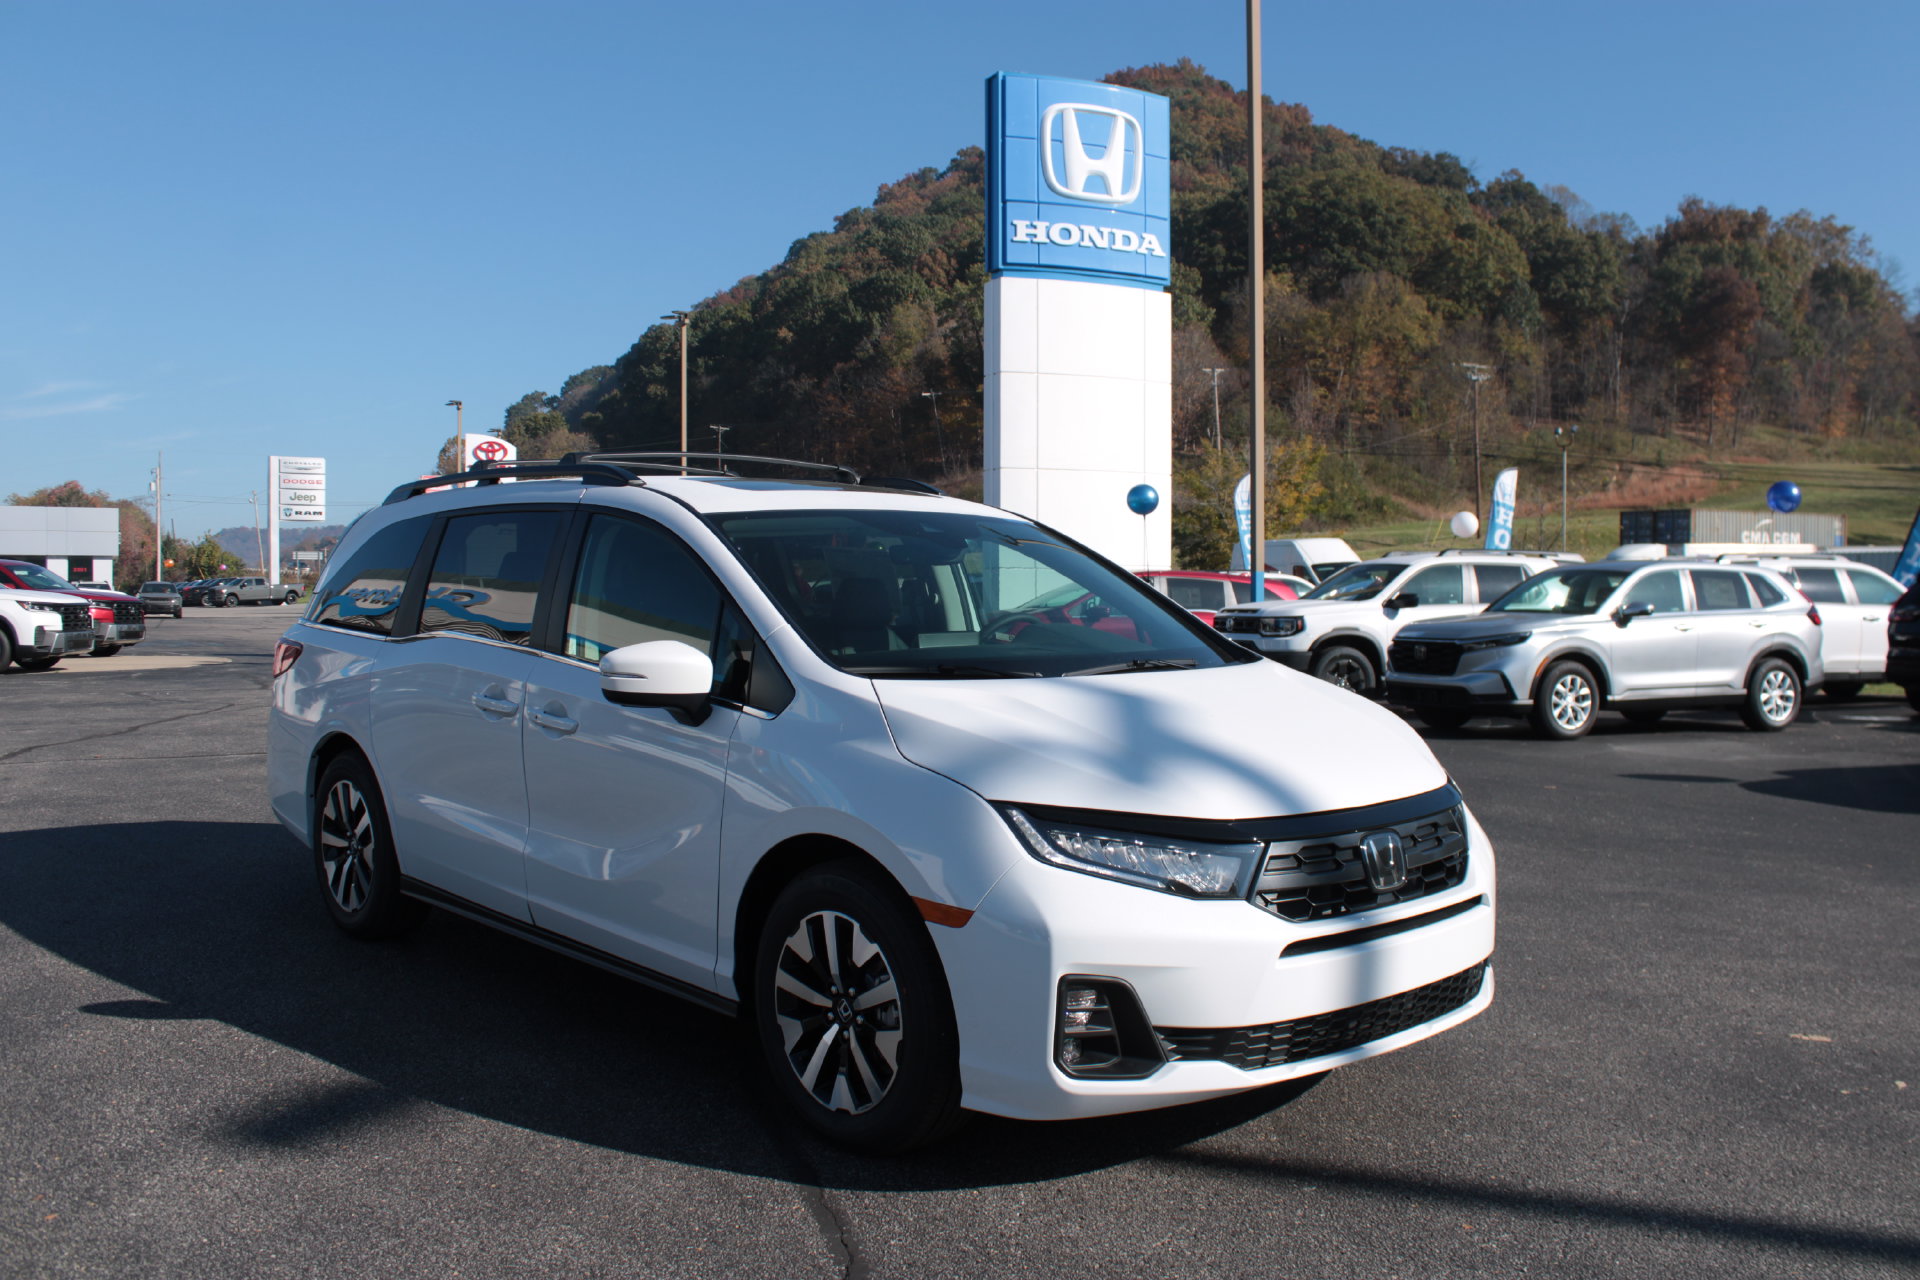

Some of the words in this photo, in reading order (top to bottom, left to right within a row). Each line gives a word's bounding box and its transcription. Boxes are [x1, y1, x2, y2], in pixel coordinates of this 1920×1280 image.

[1012, 219, 1166, 257] HONDA
[289, 491, 317, 503] Jeep
[1742, 530, 1771, 544] CMA
